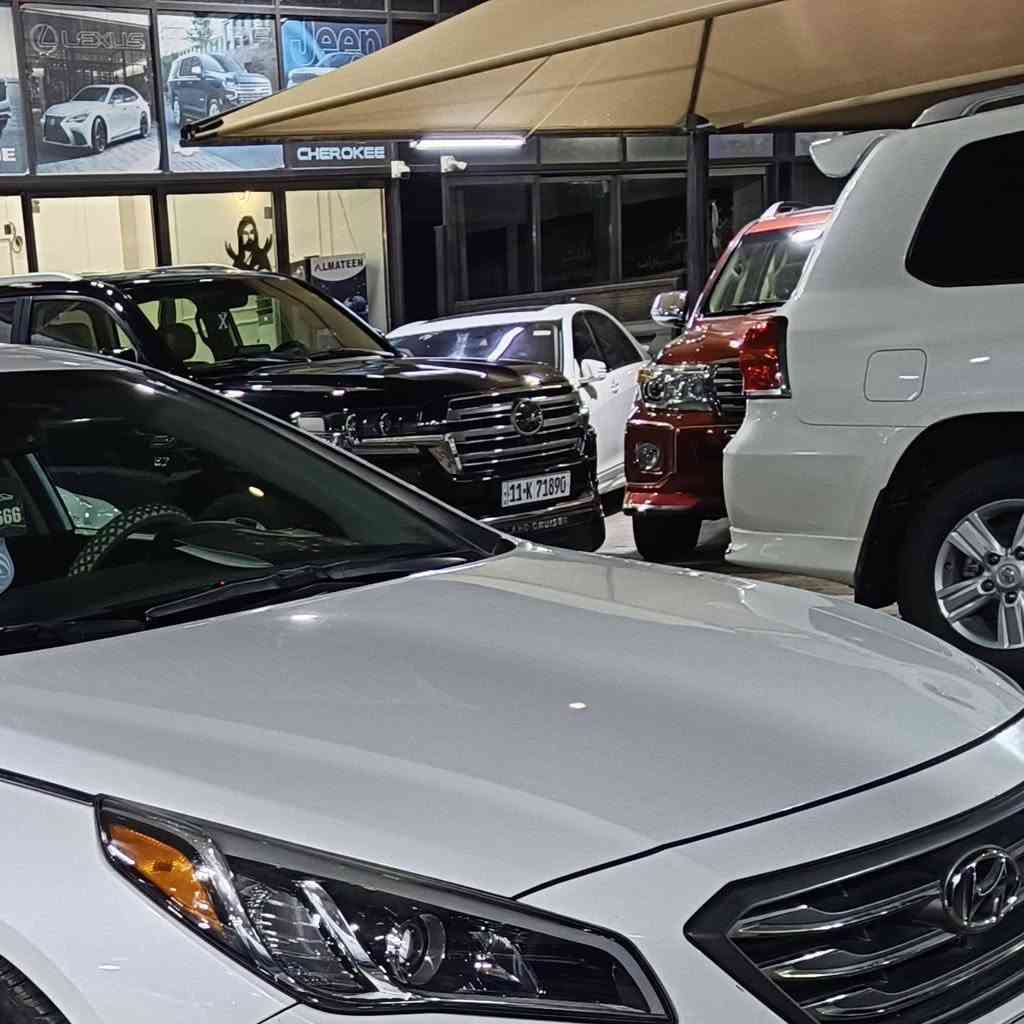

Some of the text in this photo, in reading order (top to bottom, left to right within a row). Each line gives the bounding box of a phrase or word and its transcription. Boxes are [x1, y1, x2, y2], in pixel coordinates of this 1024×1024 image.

[61, 30, 145, 50] LEXUS
[296, 146, 385, 161] CHEROKEE
[314, 258, 364, 272] ALMATEEN
[536, 477, 567, 498] 71890
